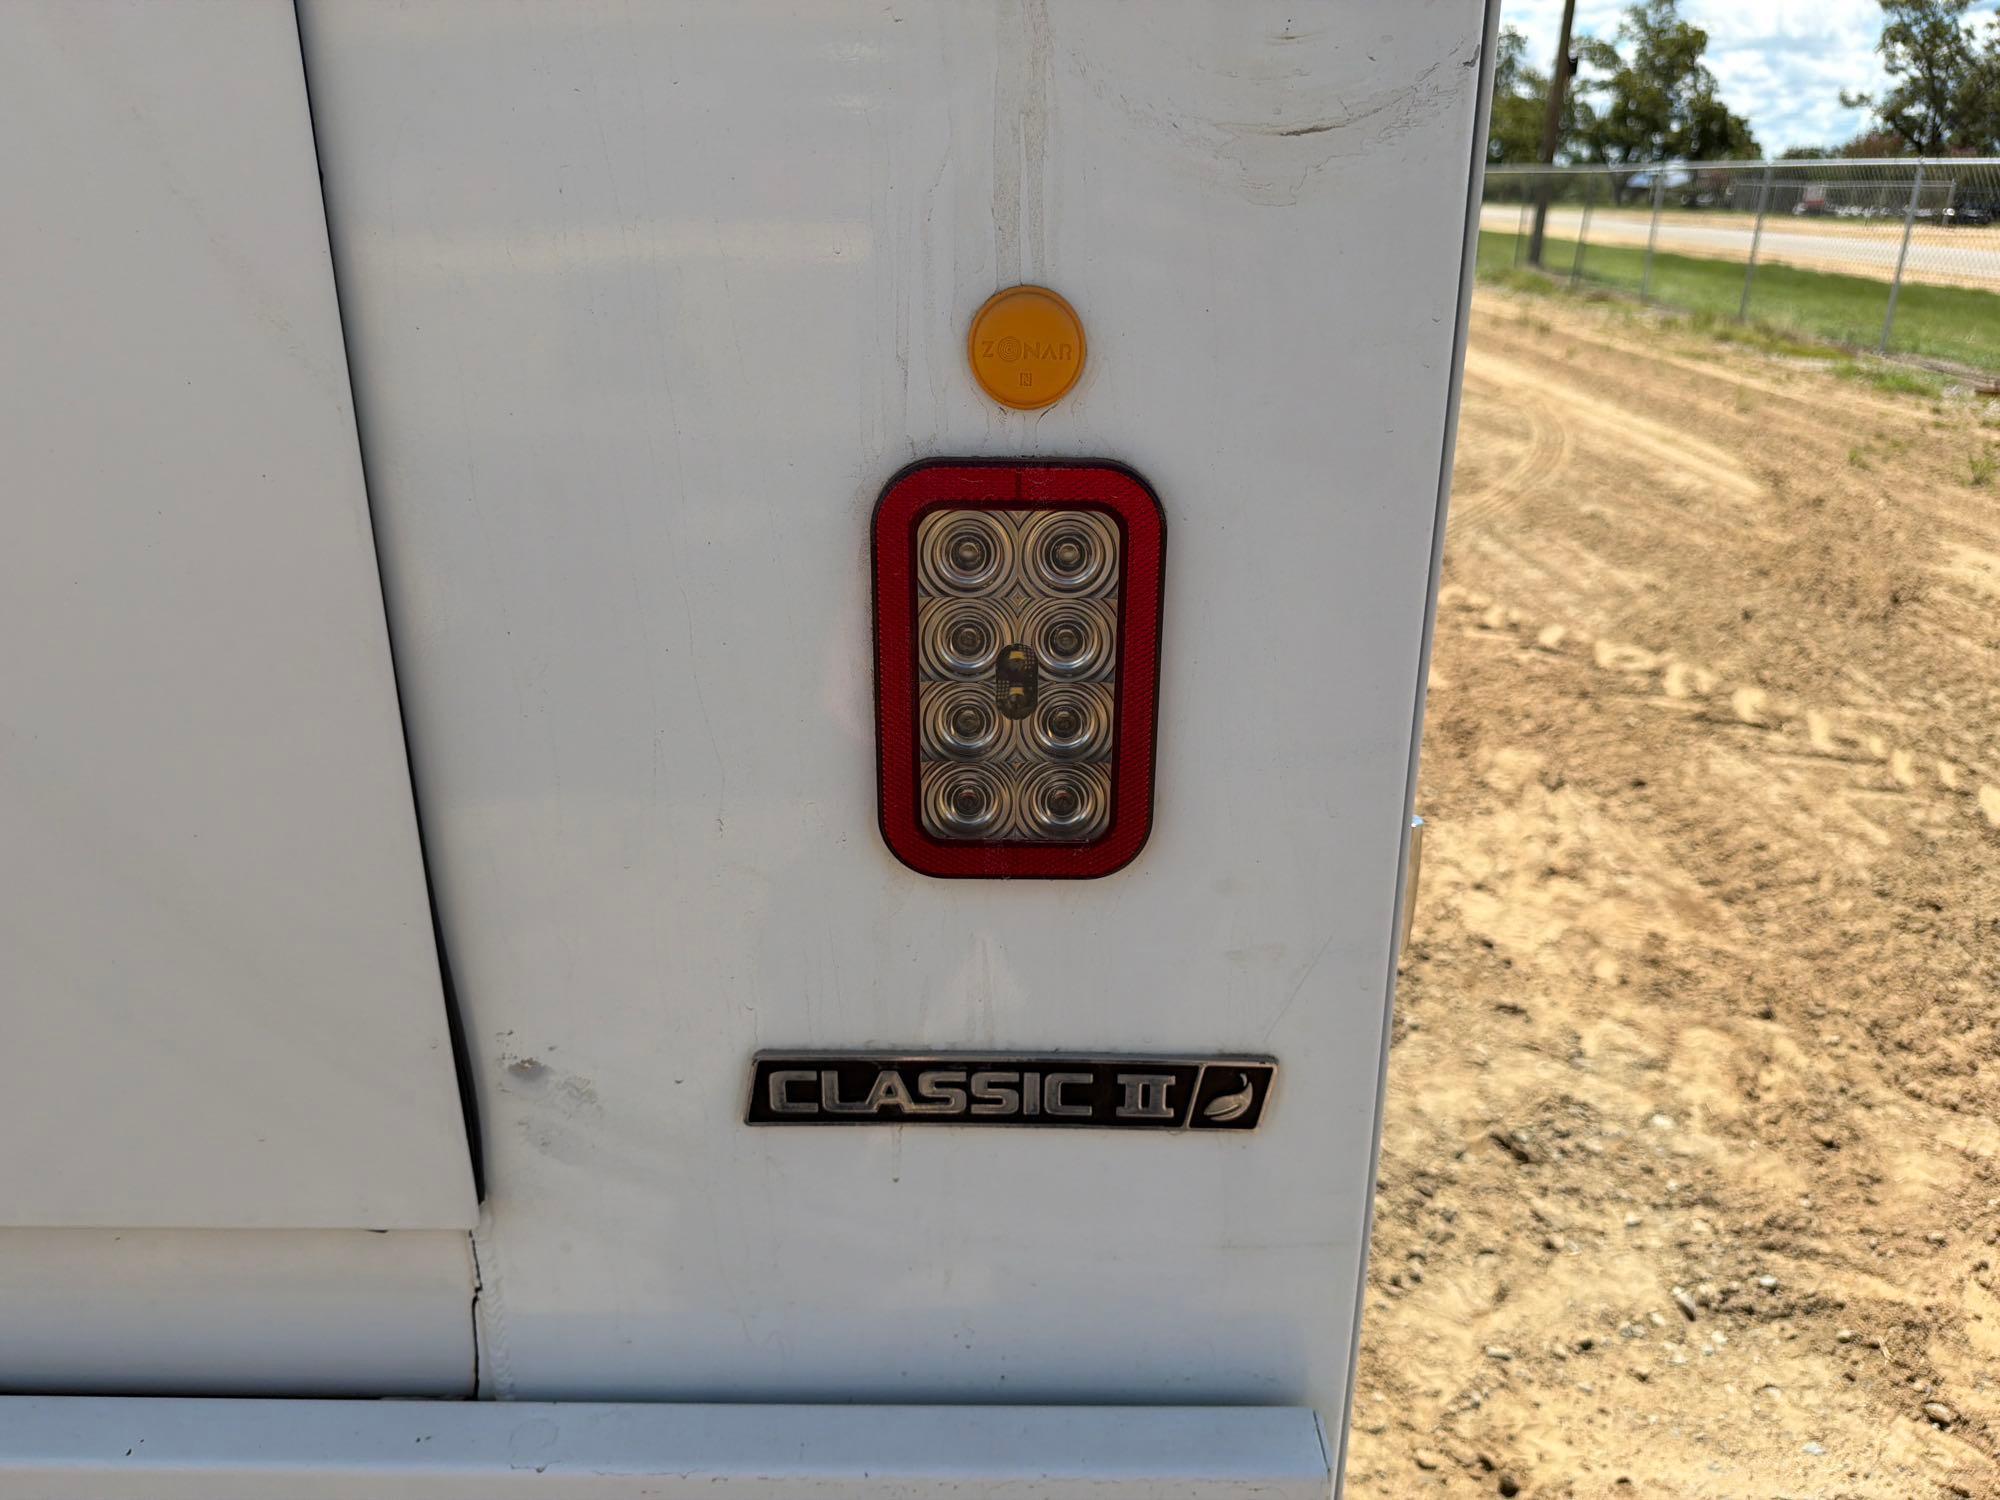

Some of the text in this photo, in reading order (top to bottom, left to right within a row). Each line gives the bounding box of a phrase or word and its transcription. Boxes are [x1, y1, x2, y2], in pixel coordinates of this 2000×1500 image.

[981, 337, 1073, 362] ZONAR
[768, 1070, 1175, 1118] CLASSIC II
